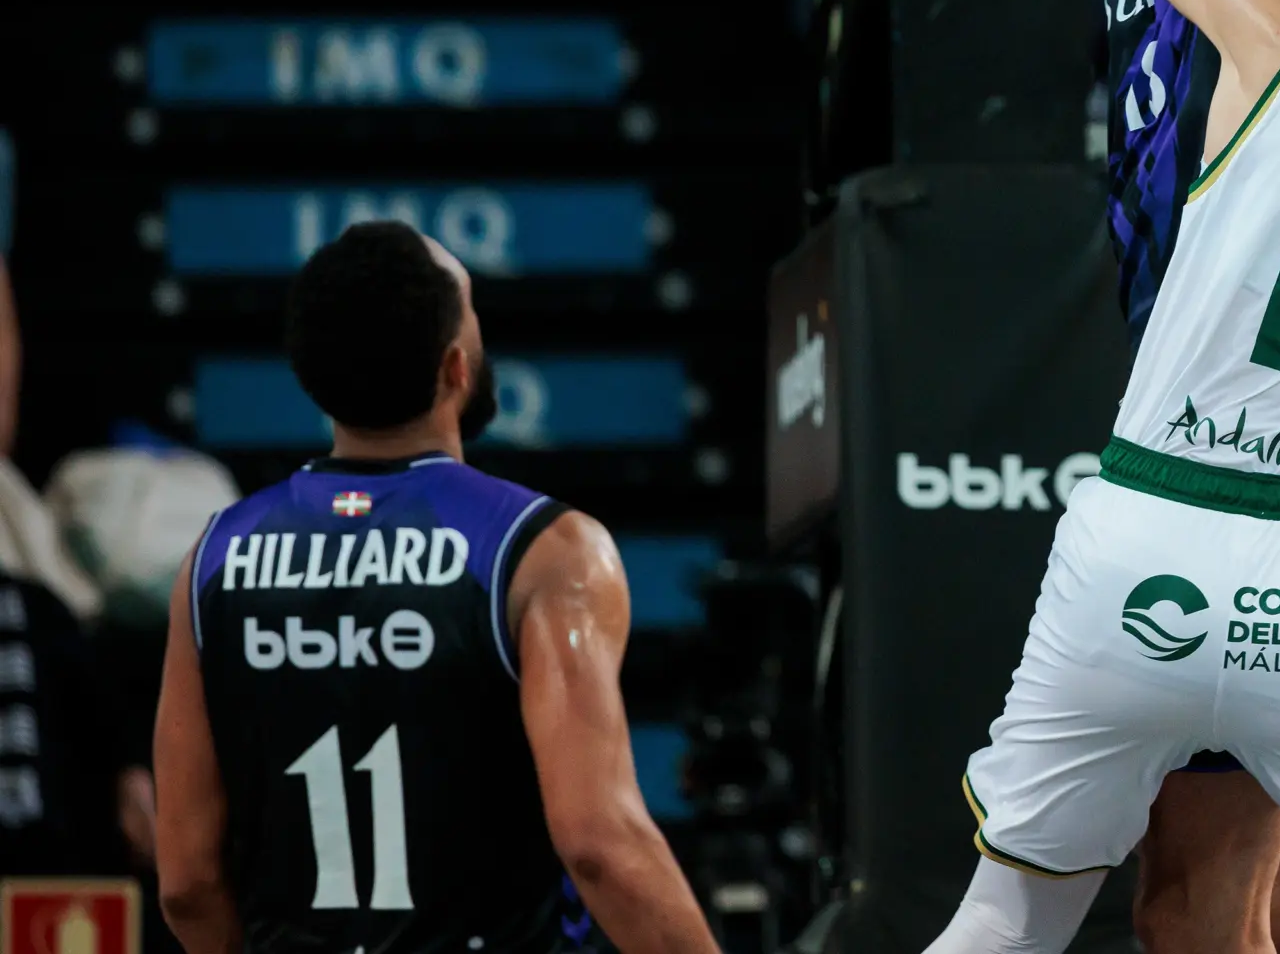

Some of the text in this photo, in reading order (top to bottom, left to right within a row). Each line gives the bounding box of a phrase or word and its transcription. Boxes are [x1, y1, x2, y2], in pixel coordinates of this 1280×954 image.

[270, 22, 488, 108] IMQ
[223, 527, 470, 591] HILLIARD
[284, 723, 415, 910] 11
